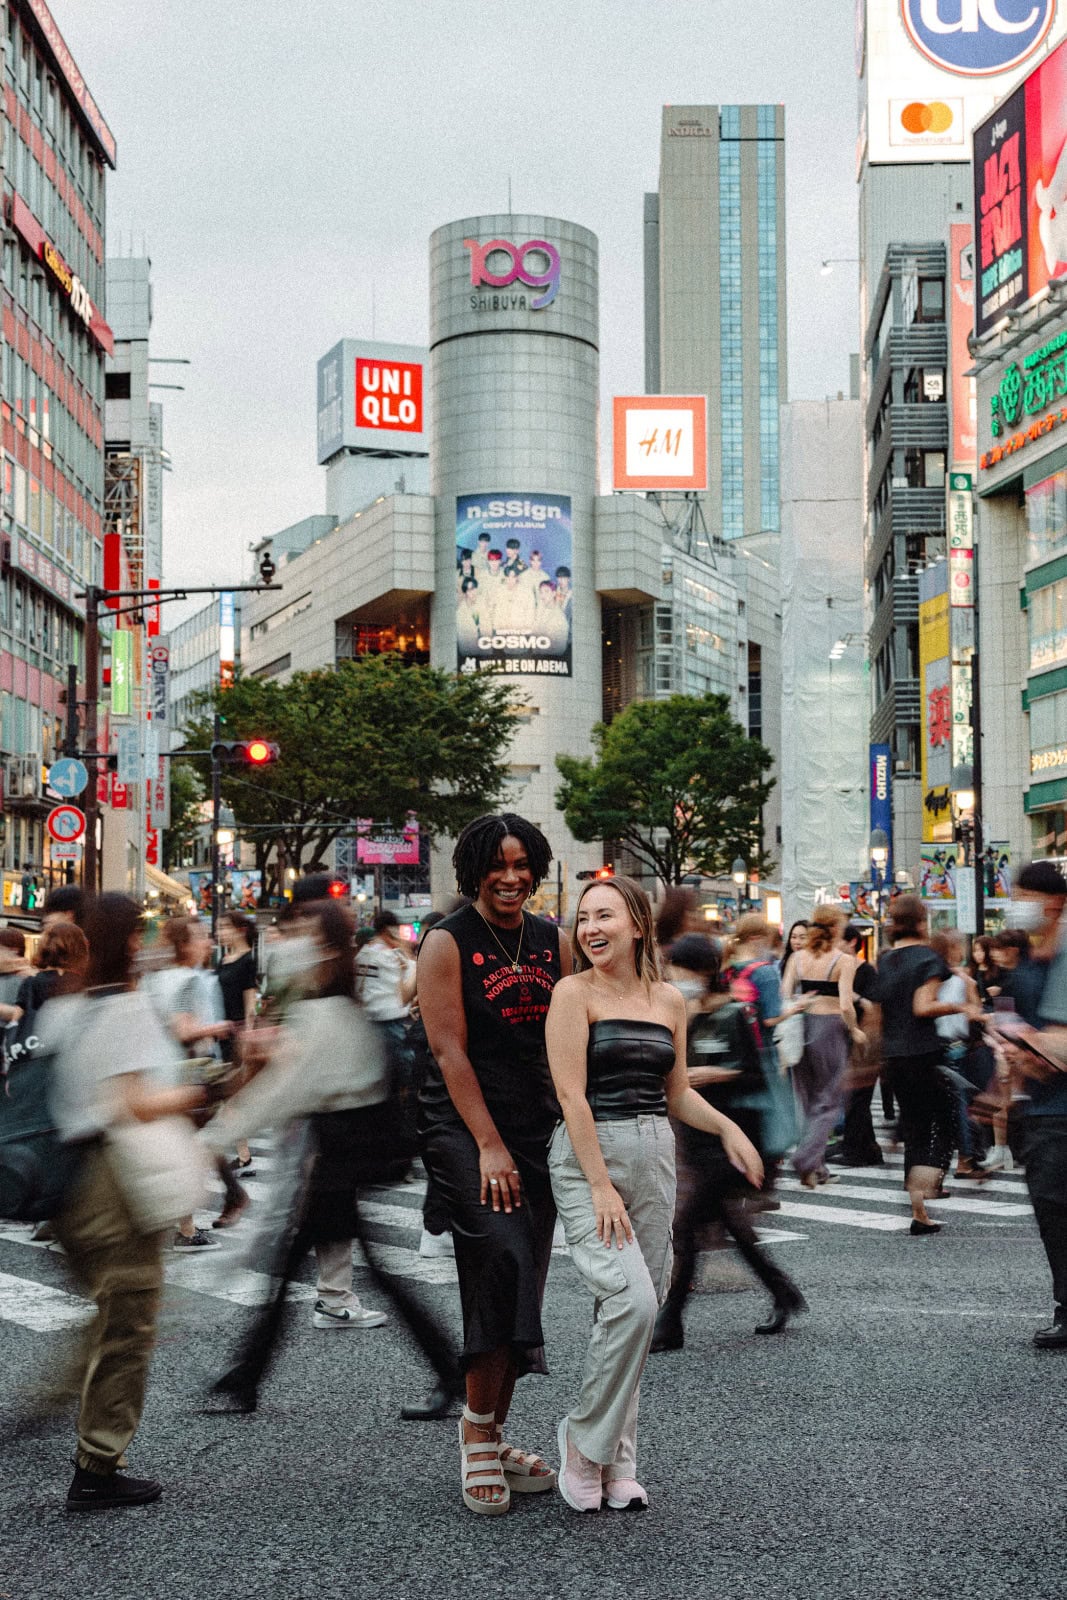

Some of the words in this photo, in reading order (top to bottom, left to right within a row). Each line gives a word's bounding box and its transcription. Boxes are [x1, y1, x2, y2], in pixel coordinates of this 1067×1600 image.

[463, 238, 560, 309] 109
[470, 295, 527, 311] SHIBUYA
[362, 366, 411, 396] UNI
[362, 395, 416, 426] QLO
[467, 500, 562, 521] n.SSign
[478, 635, 551, 650] COSMO
[521, 659, 536, 673] ON
[875, 754, 887, 800] MIZUHO
